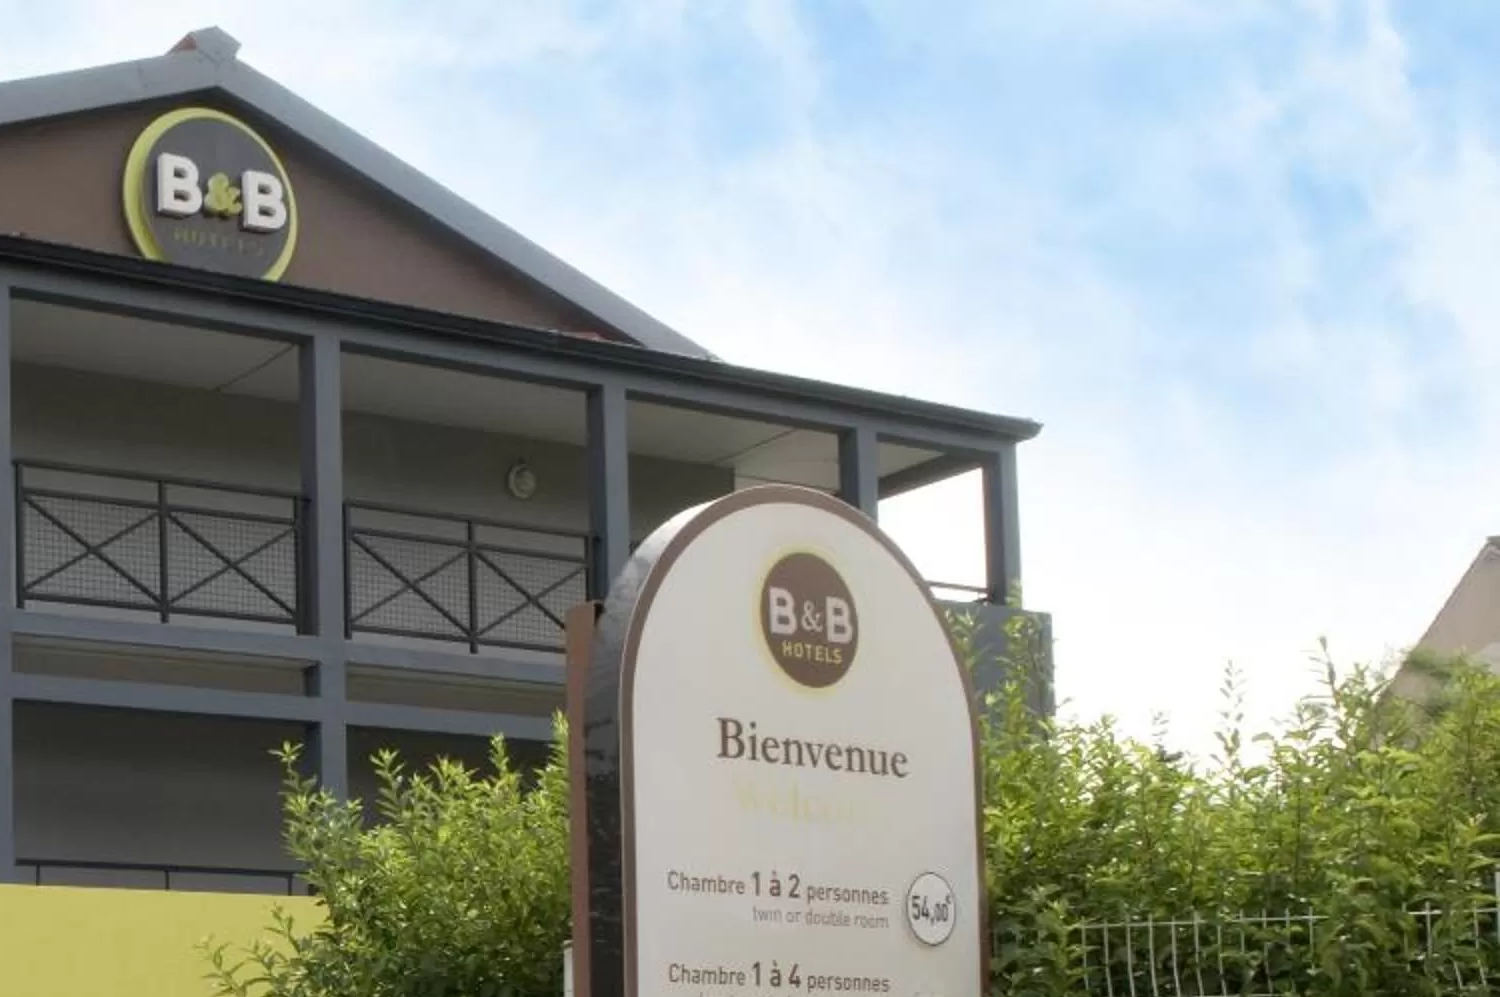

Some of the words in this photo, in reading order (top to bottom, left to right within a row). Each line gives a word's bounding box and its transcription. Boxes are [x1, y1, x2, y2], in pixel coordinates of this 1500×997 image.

[156, 152, 287, 233] B&B
[768, 587, 854, 644] B&B
[781, 640, 844, 665] HOTELS
[717, 716, 911, 778] Bienvenue
[666, 869, 745, 896] Chambre
[750, 871, 761, 896] 1
[769, 869, 781, 897] à
[788, 874, 801, 899] 2
[806, 882, 890, 905] personnes
[752, 906, 782, 923] twin
[786, 911, 801, 924] or
[805, 908, 852, 927] double
[854, 915, 890, 929] room
[667, 962, 746, 986] Chambre
[751, 963, 761, 987] 1
[769, 960, 782, 988] à
[788, 964, 801, 989] 4
[807, 973, 891, 993] personnes
